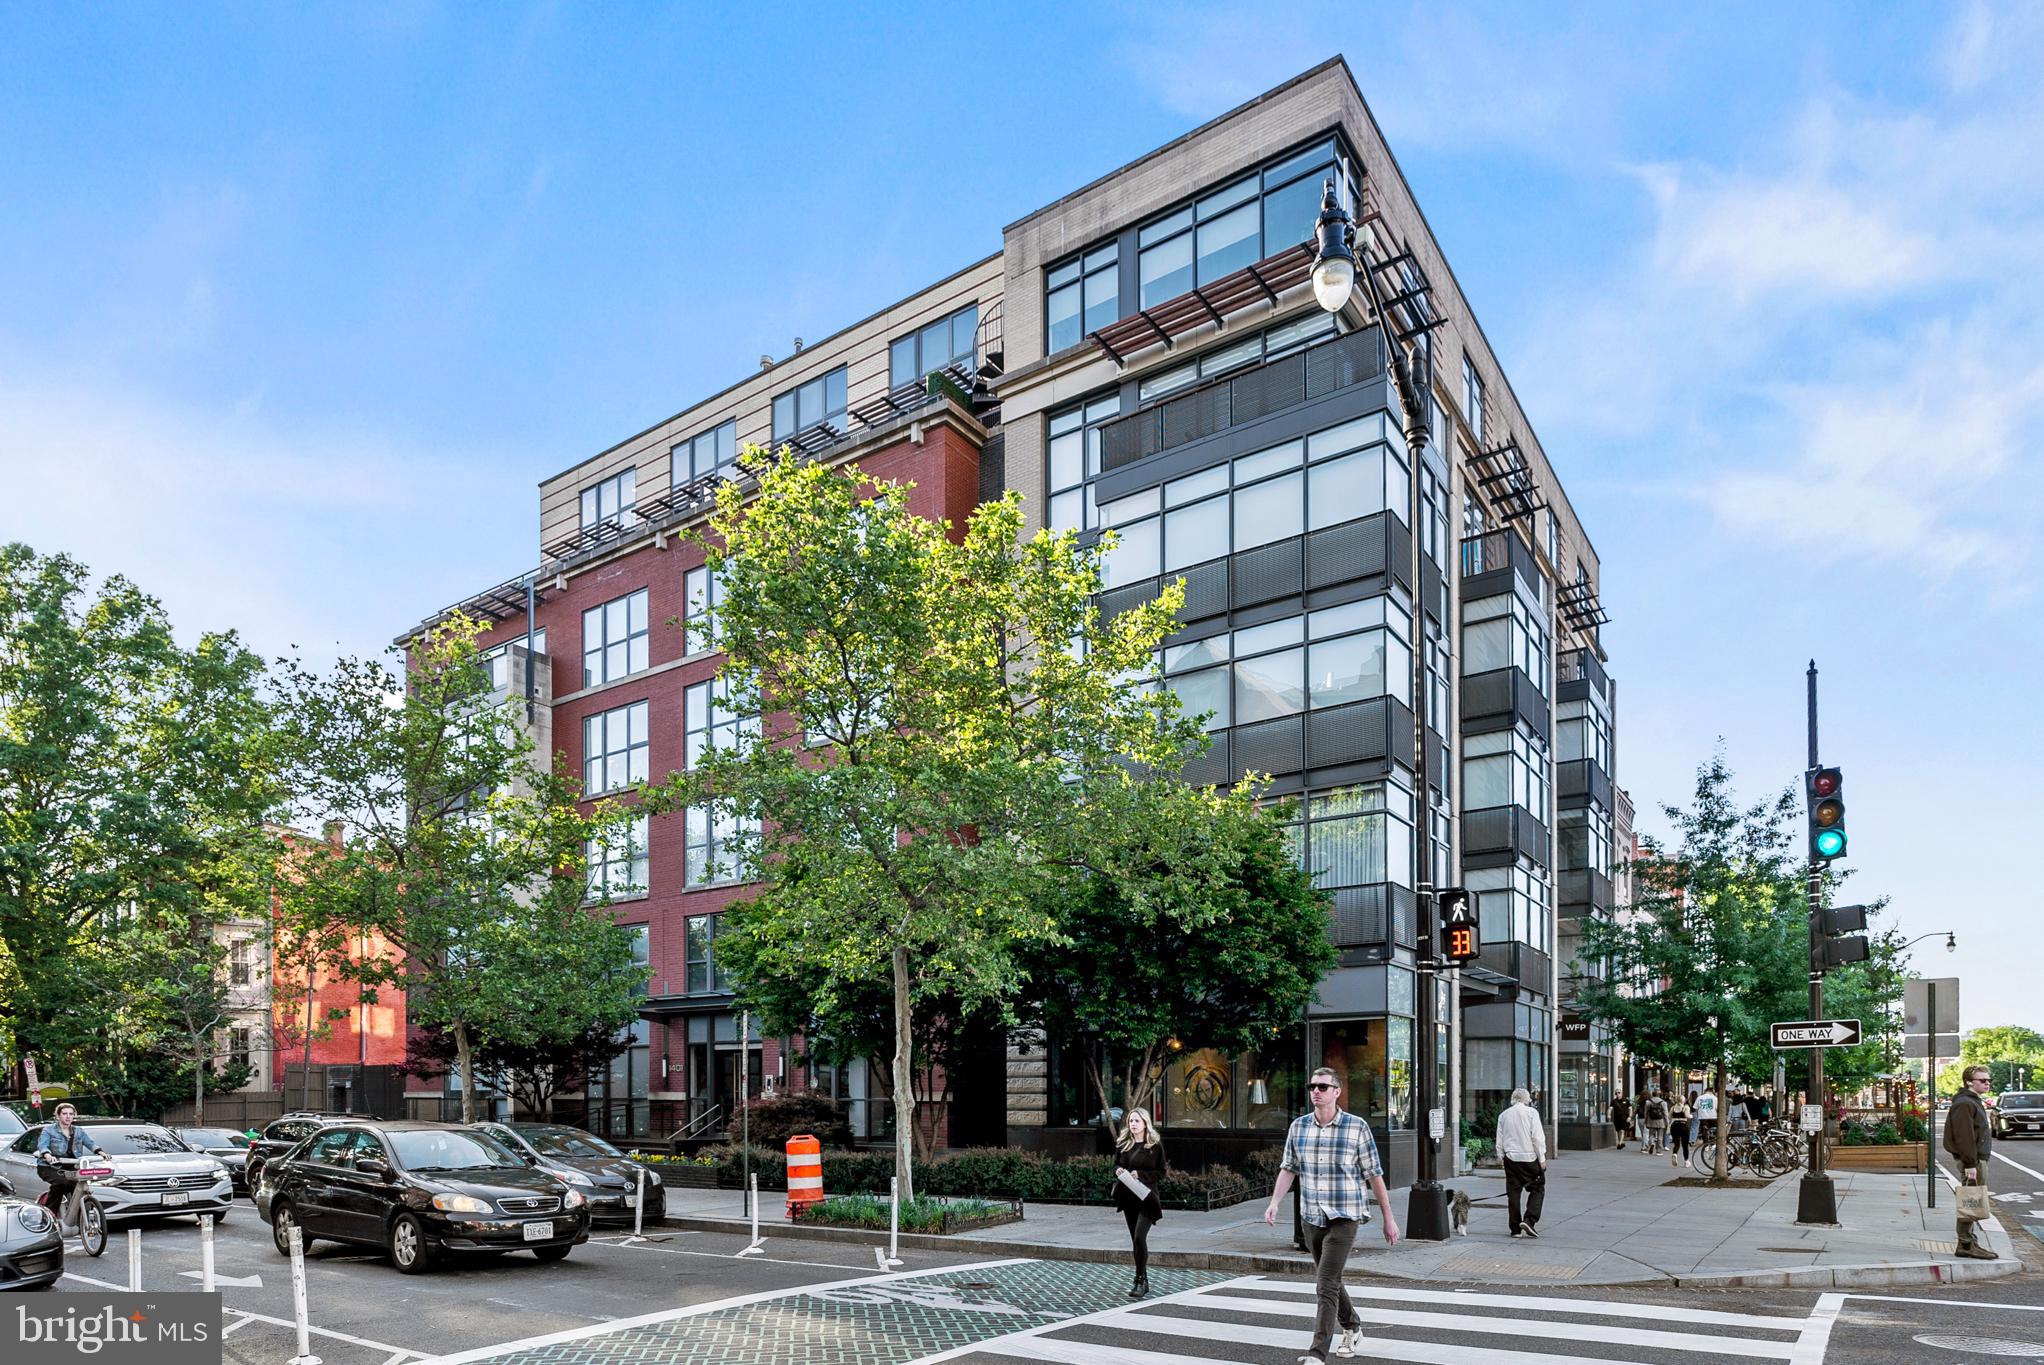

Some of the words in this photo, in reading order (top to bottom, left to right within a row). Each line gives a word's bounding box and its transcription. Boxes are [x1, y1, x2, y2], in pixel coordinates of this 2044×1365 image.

[1452, 930, 1470, 955] 33
[1565, 1023, 1587, 1031] WFP
[1781, 1030, 1804, 1040] ONE
[1808, 1028, 1832, 1039] WAY
